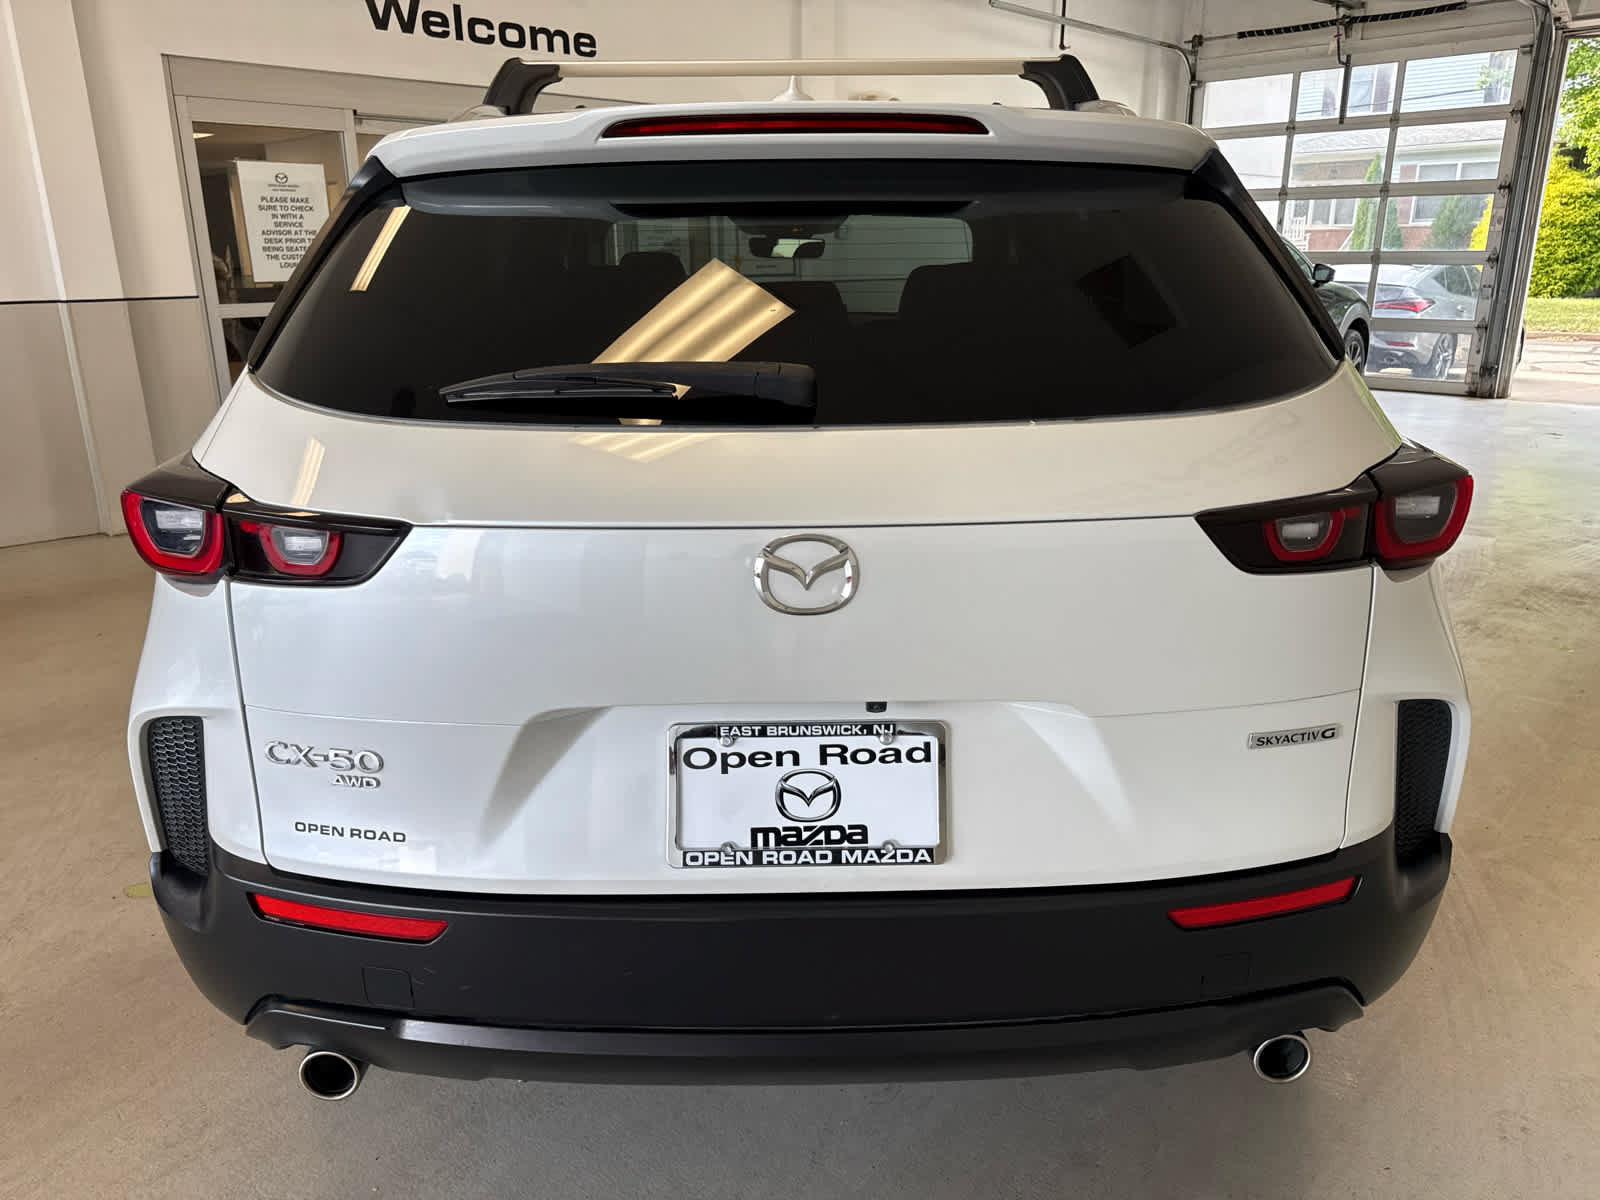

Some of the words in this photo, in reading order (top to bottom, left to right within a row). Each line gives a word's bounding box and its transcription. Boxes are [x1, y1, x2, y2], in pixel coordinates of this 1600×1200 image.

[365, 0, 597, 58] Welcome
[719, 725, 762, 737] EAST
[766, 725, 868, 737] BRUNSWICK,
[872, 724, 895, 735] NJ
[264, 740, 384, 774] CX-50
[683, 747, 800, 775] Open
[819, 742, 932, 766] Road
[331, 774, 382, 790] AWD
[294, 821, 345, 838] OPEN
[349, 828, 407, 843] ROAD
[685, 850, 753, 867] OPEN
[762, 849, 834, 865] ROAD
[841, 848, 932, 864] MAZDA
